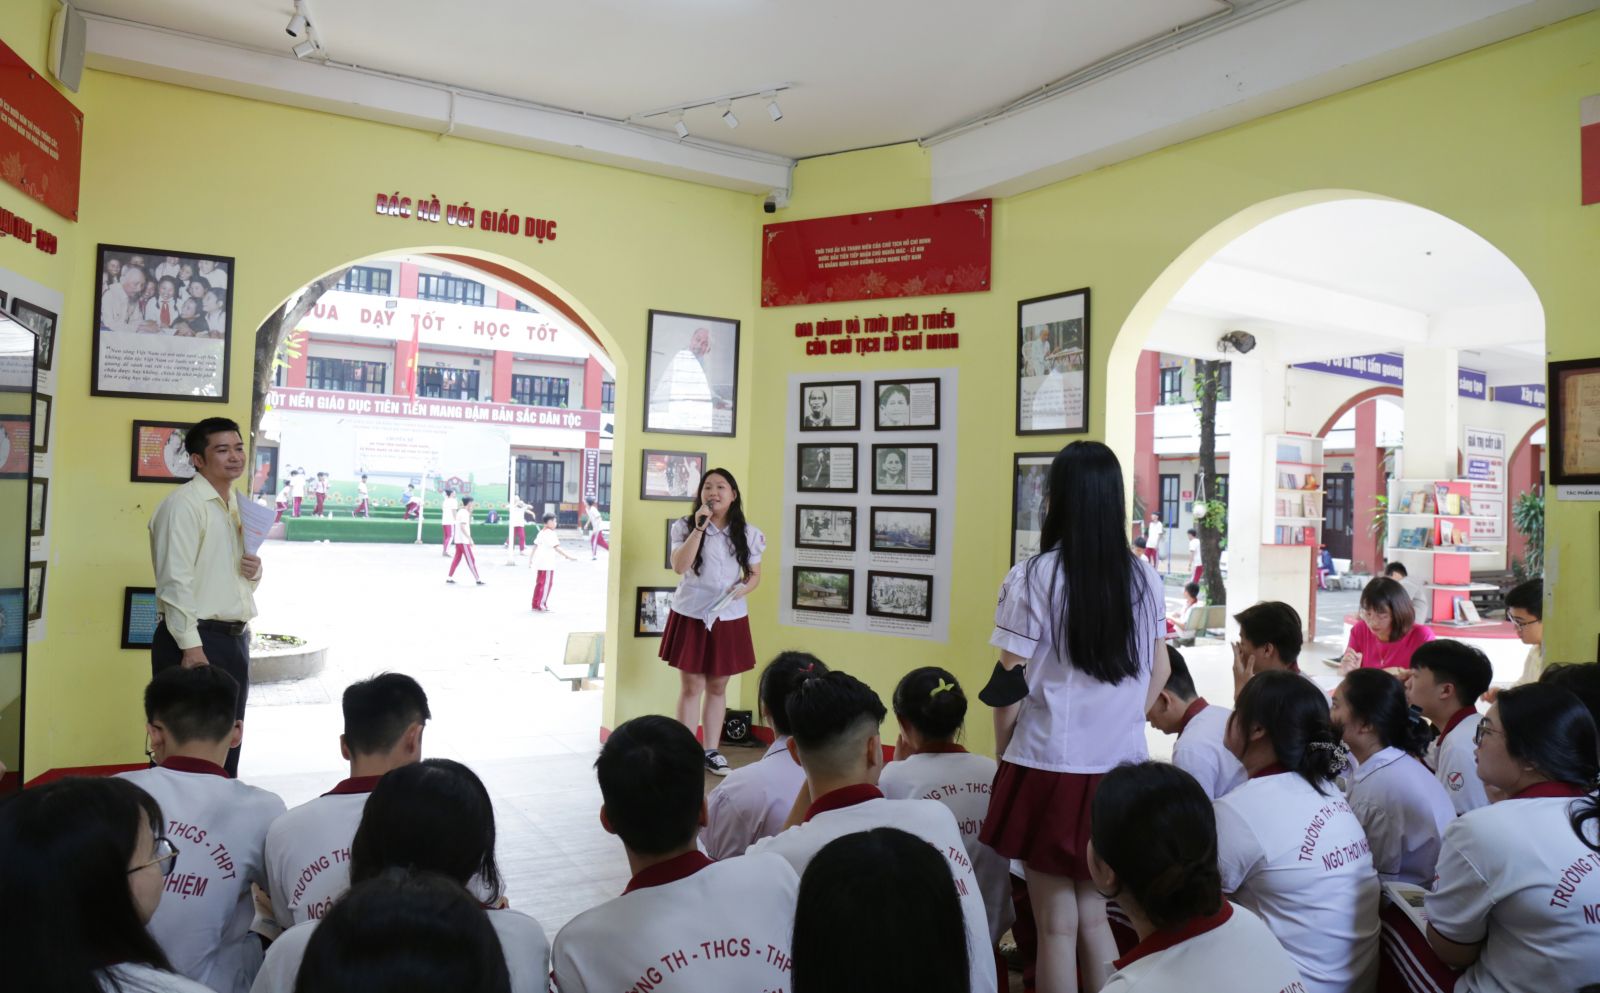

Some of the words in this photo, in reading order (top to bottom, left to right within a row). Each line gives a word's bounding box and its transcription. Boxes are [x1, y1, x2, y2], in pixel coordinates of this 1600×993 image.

[376, 191, 412, 218] BÁC
[417, 194, 441, 222] HỒ
[446, 201, 475, 228] VỚI
[480, 208, 520, 235] GIÁO
[524, 217, 557, 243] DỤC
[360, 308, 395, 328] DẠY
[410, 311, 445, 331] TỐT
[473, 320, 510, 340] HỌC
[526, 322, 558, 342] TỐT
[855, 337, 880, 356] TỊCH
[902, 332, 922, 350] CHÍ
[317, 394, 344, 410] GIÁO
[347, 398, 372, 415] DỤC
[430, 404, 462, 419] MANG
[464, 405, 489, 422] ĐẬM
[491, 406, 514, 421] BẢN
[538, 411, 560, 425] DÂN
[562, 412, 582, 428] TỘC
[942, 784, 958, 796] TH
[958, 817, 977, 835] HỜI
[1298, 815, 1325, 862] TRƯỜNG
[168, 820, 207, 844] THCS
[210, 843, 236, 880] THPT
[1322, 846, 1344, 872] NGÔ
[164, 872, 208, 899] HIỆM
[292, 856, 330, 906] TRƯỜNG
[332, 848, 351, 863] TH
[1550, 858, 1592, 908] TRƯỜNG
[660, 950, 689, 973] TH
[700, 938, 751, 960] THCS
[766, 944, 793, 972] THP
